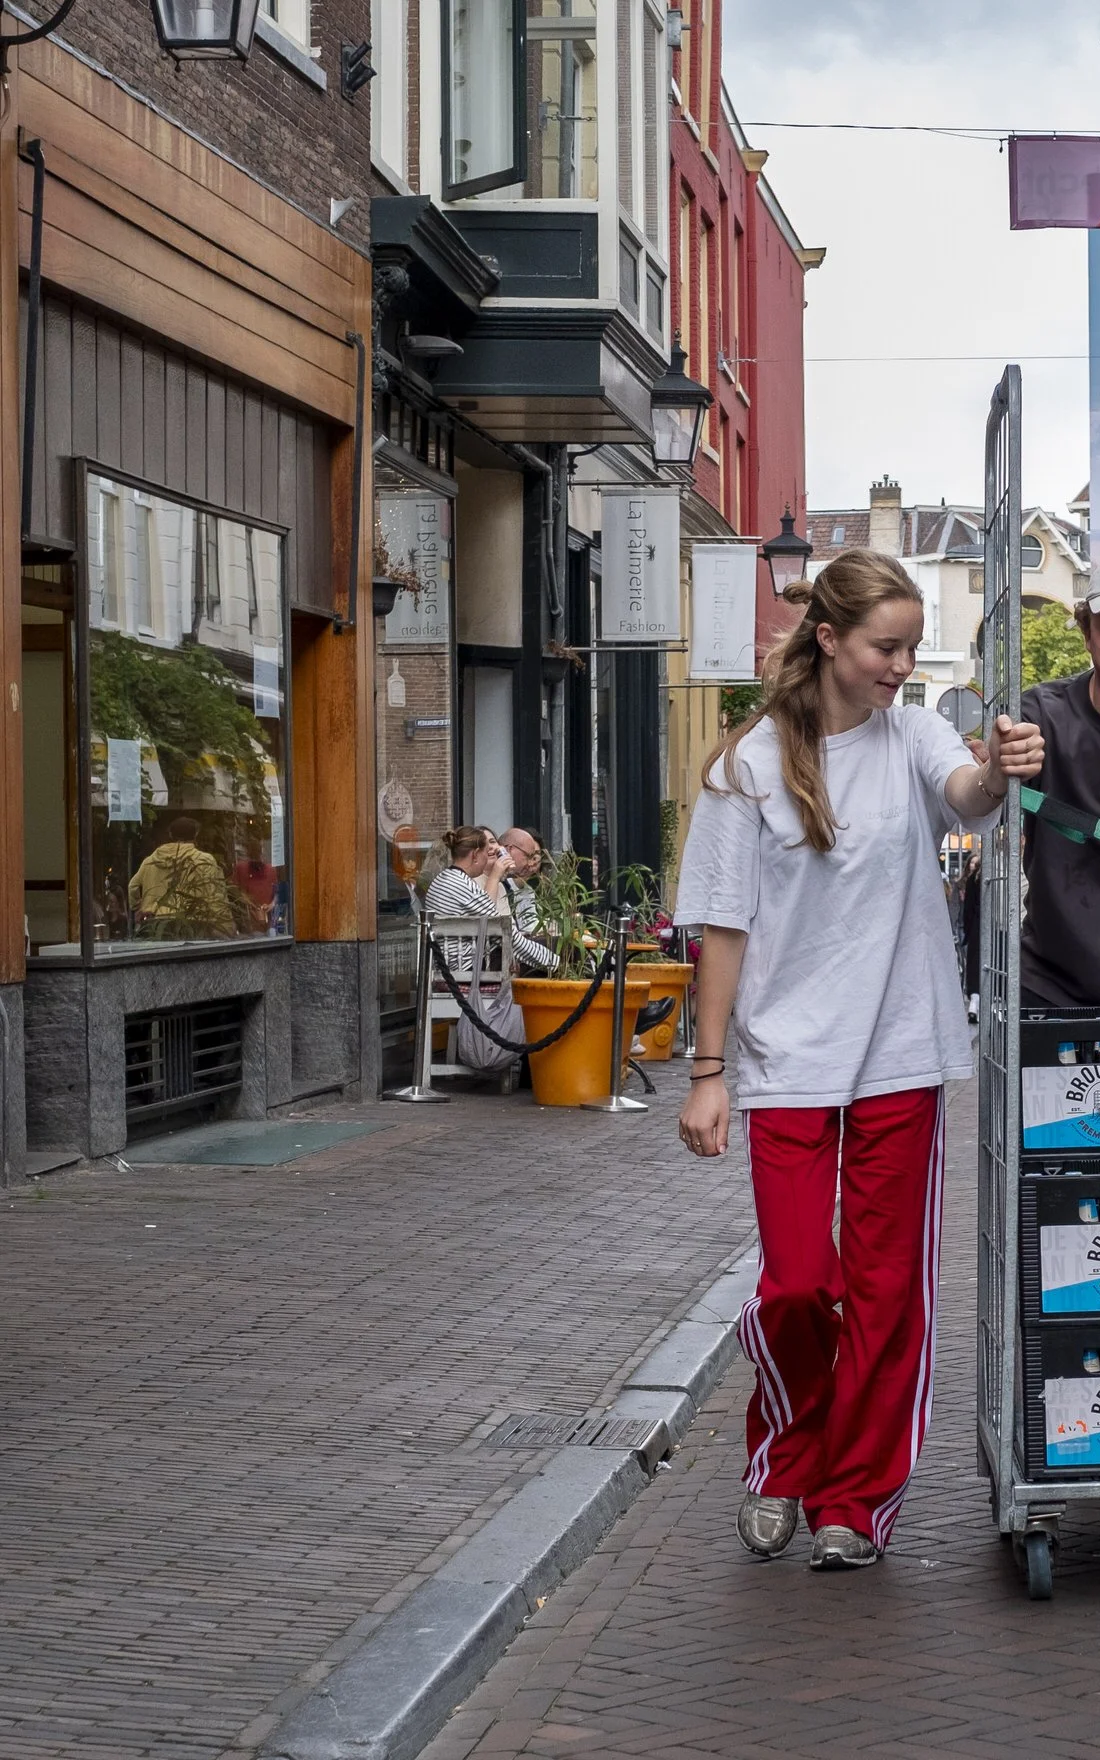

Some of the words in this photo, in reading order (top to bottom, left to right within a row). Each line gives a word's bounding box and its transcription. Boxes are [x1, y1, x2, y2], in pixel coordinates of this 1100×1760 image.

[627, 500, 647, 520] La
[627, 528, 648, 612] Palmerie
[619, 619, 666, 633] Fashion
